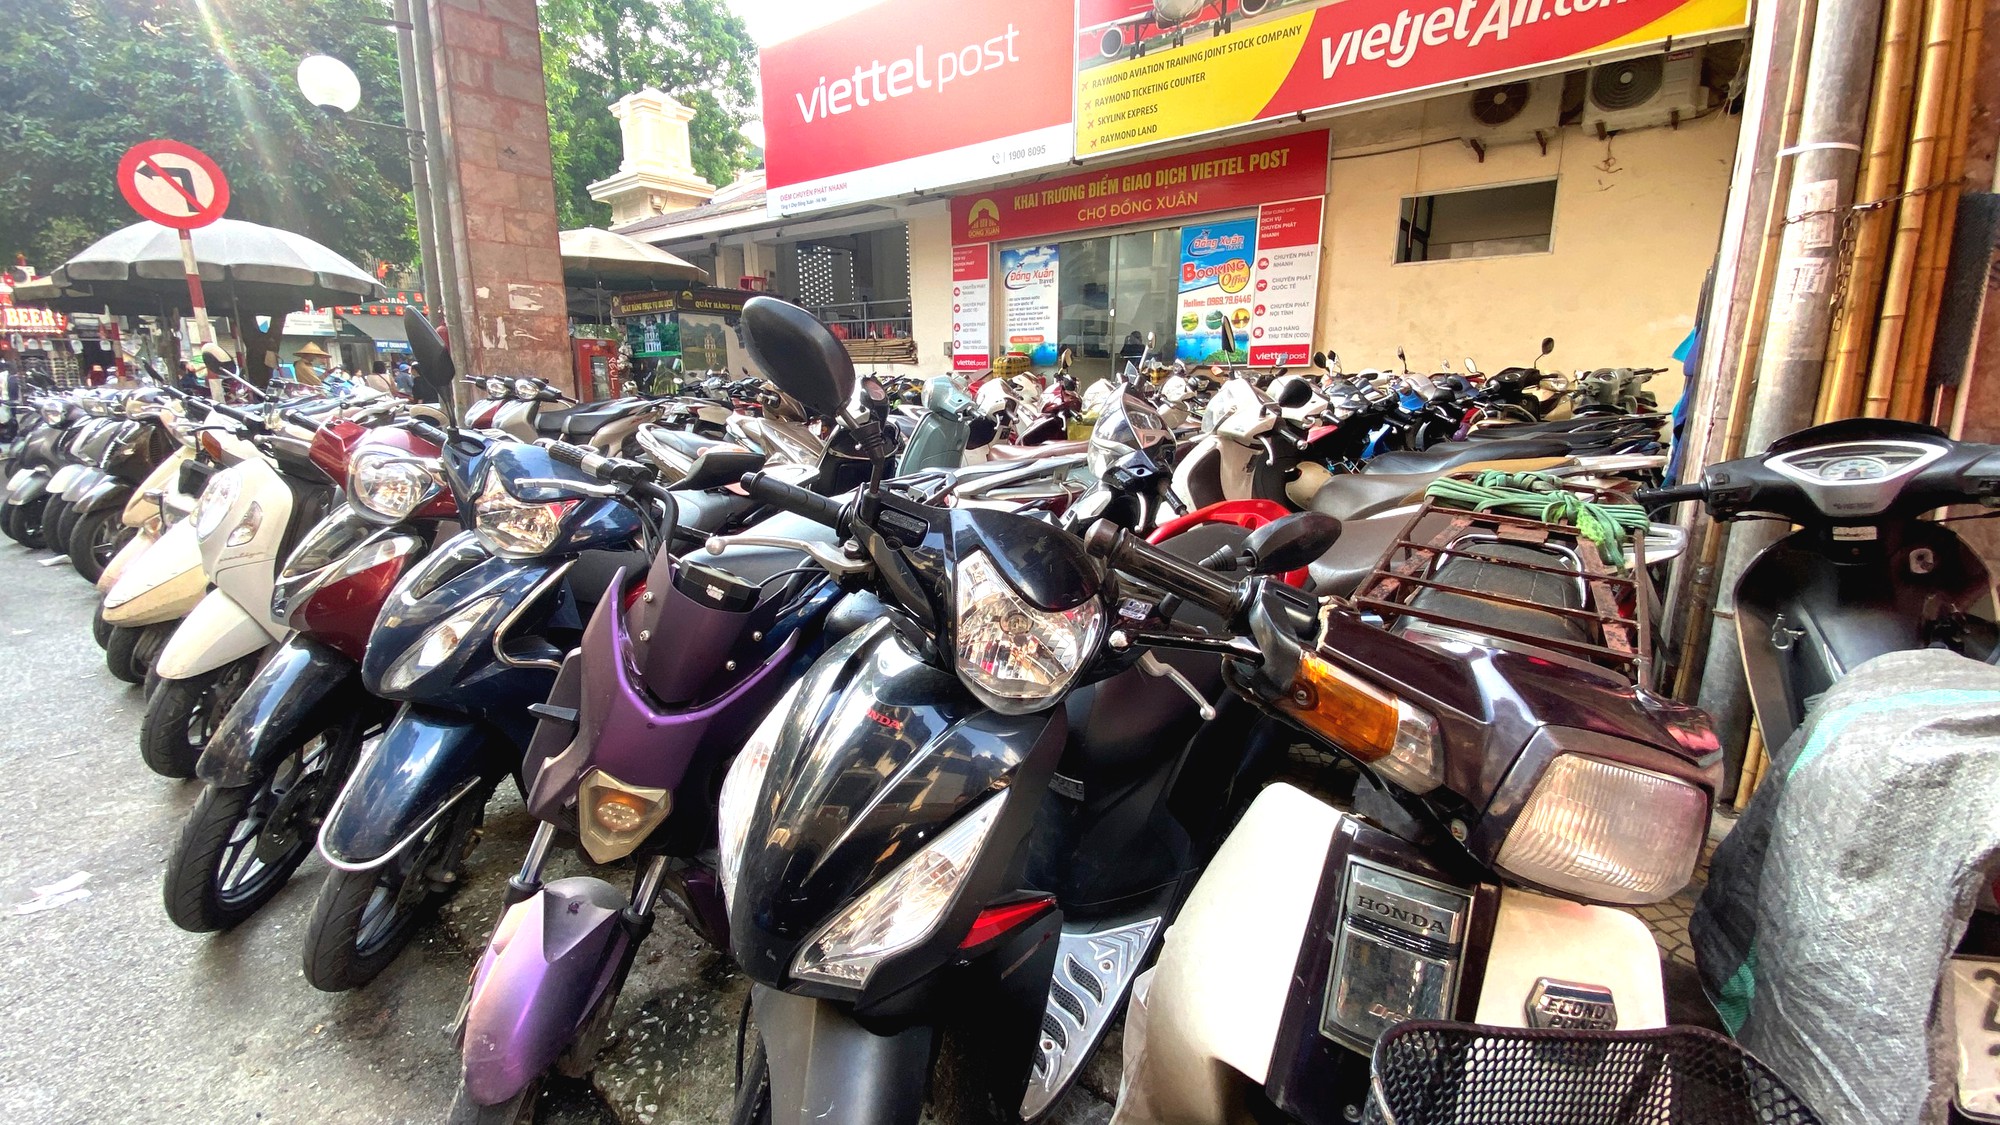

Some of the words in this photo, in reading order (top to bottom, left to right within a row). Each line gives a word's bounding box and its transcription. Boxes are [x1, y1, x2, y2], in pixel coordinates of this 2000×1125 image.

[795, 45, 932, 123] viettel
[938, 23, 1020, 93] post
[1092, 71, 1128, 89] RAYMOND
[1129, 63, 1165, 79] AVIATION
[1165, 52, 1203, 70] TRAINING
[1204, 46, 1226, 61] JOINT
[1228, 37, 1254, 53] STOCK
[1256, 25, 1302, 45] COMPANY
[1094, 91, 1131, 108] RAYMOND
[1132, 81, 1169, 98] TICKETING
[1170, 72, 1206, 89] COUNTER
[1097, 111, 1127, 126] SKYLINK
[1127, 104, 1158, 119] EXPRESS
[1100, 128, 1137, 144] RAYMOND
[1137, 124, 1158, 135] LAND
[1008, 149, 1025, 160] 1900
[1027, 144, 1046, 157] 8095
[1013, 193, 1039, 211] KHAI
[1088, 173, 1119, 198] ĐIỂM
[1122, 172, 1152, 193] GIAO
[1155, 165, 1187, 189] DỊCH
[1191, 156, 1245, 181] VIETTEL
[1249, 148, 1290, 172] POST
[1077, 203, 1107, 222] CHỢ
[1110, 198, 1152, 217] ĐỒNG
[1156, 190, 1198, 210] XUÂN
[4, 307, 57, 327] BEER
[1289, 352, 1306, 360] post
[1356, 895, 1447, 935] HONDA
